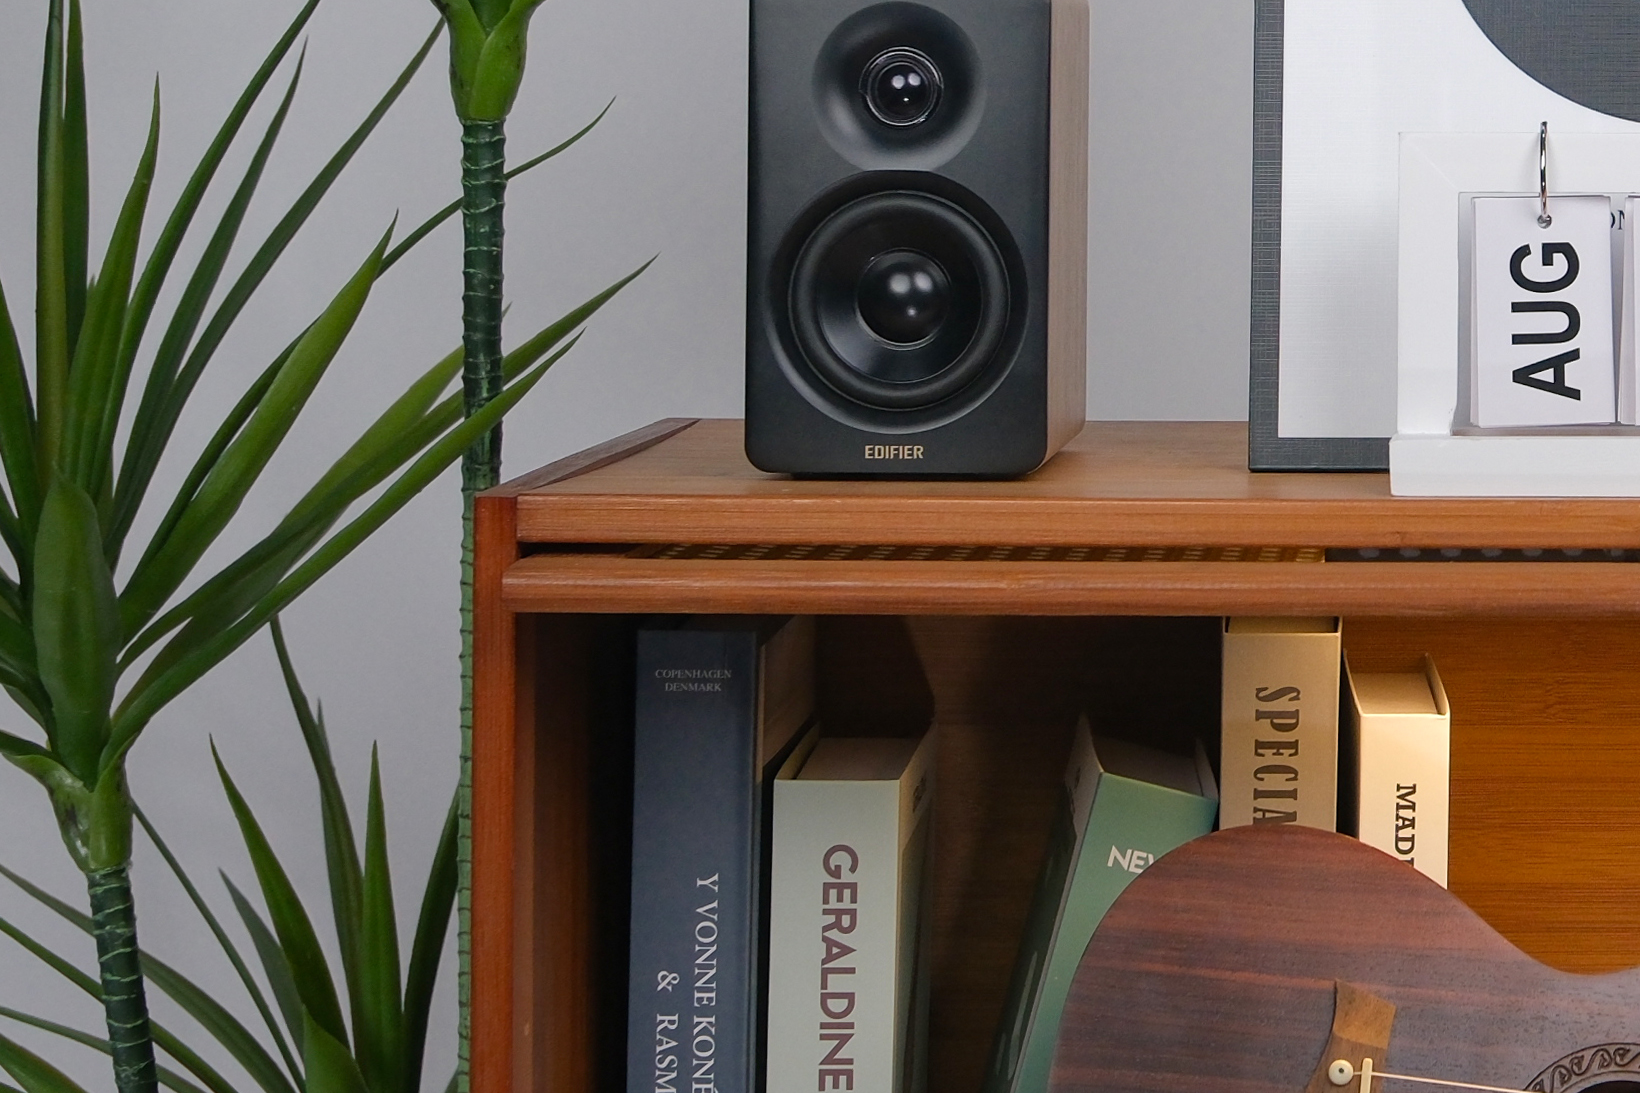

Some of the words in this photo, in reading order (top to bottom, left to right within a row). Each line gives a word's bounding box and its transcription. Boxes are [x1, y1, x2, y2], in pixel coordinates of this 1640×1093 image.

[1509, 241, 1581, 401] AUG
[864, 445, 924, 459] EDIFIER
[655, 669, 732, 679] COPENHAGEN
[665, 682, 722, 692] DENMARK
[1395, 783, 1417, 867] MAD
[1107, 845, 1155, 874] NE
[818, 844, 859, 1092] GERALDINE
[656, 970, 680, 992] &
